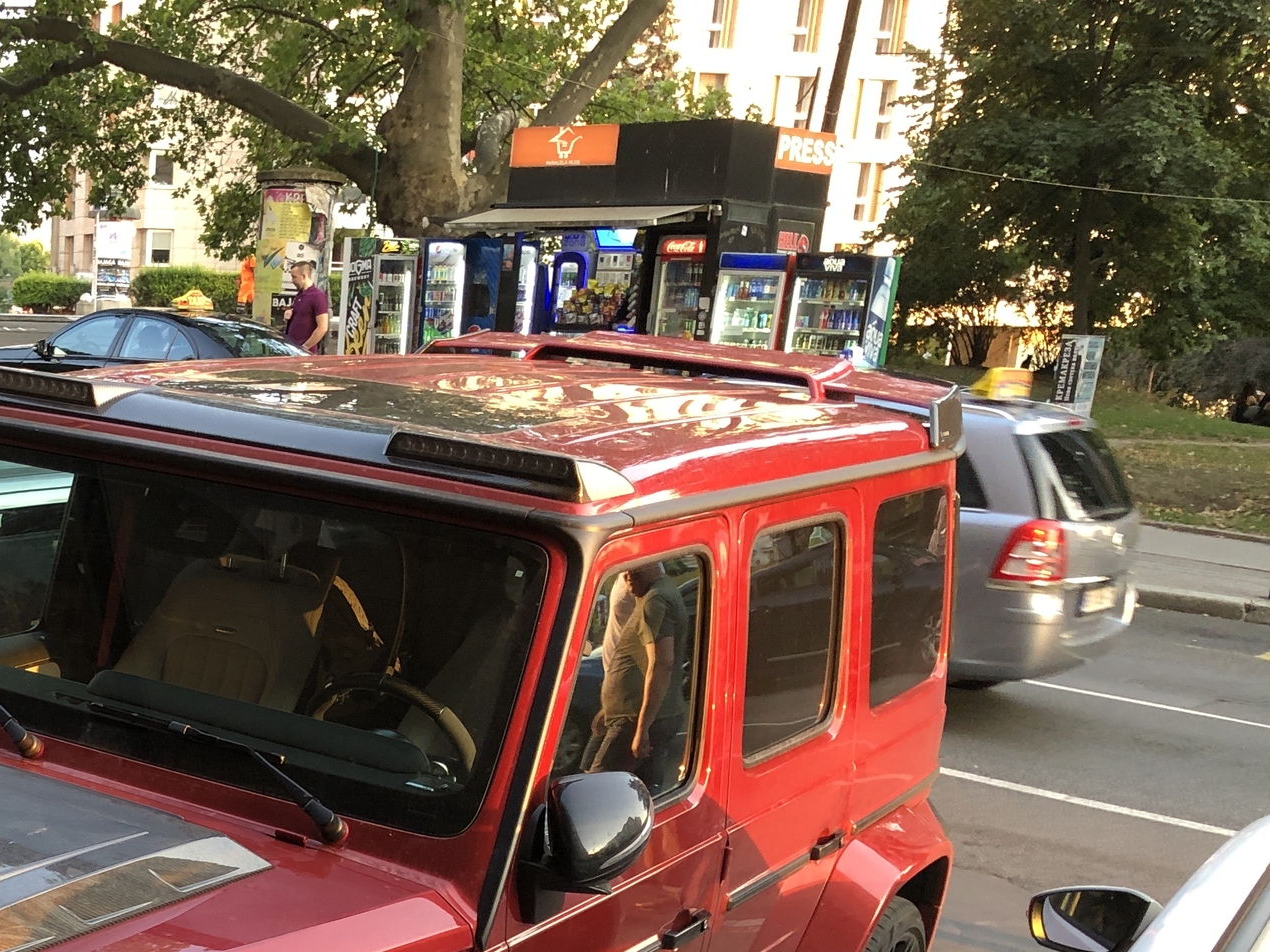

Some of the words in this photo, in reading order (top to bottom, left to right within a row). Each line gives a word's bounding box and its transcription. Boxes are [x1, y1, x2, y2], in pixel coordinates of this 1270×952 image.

[777, 134, 837, 166] PRESS
[349, 259, 371, 275] OGMA
[346, 296, 362, 338] CRAFT
